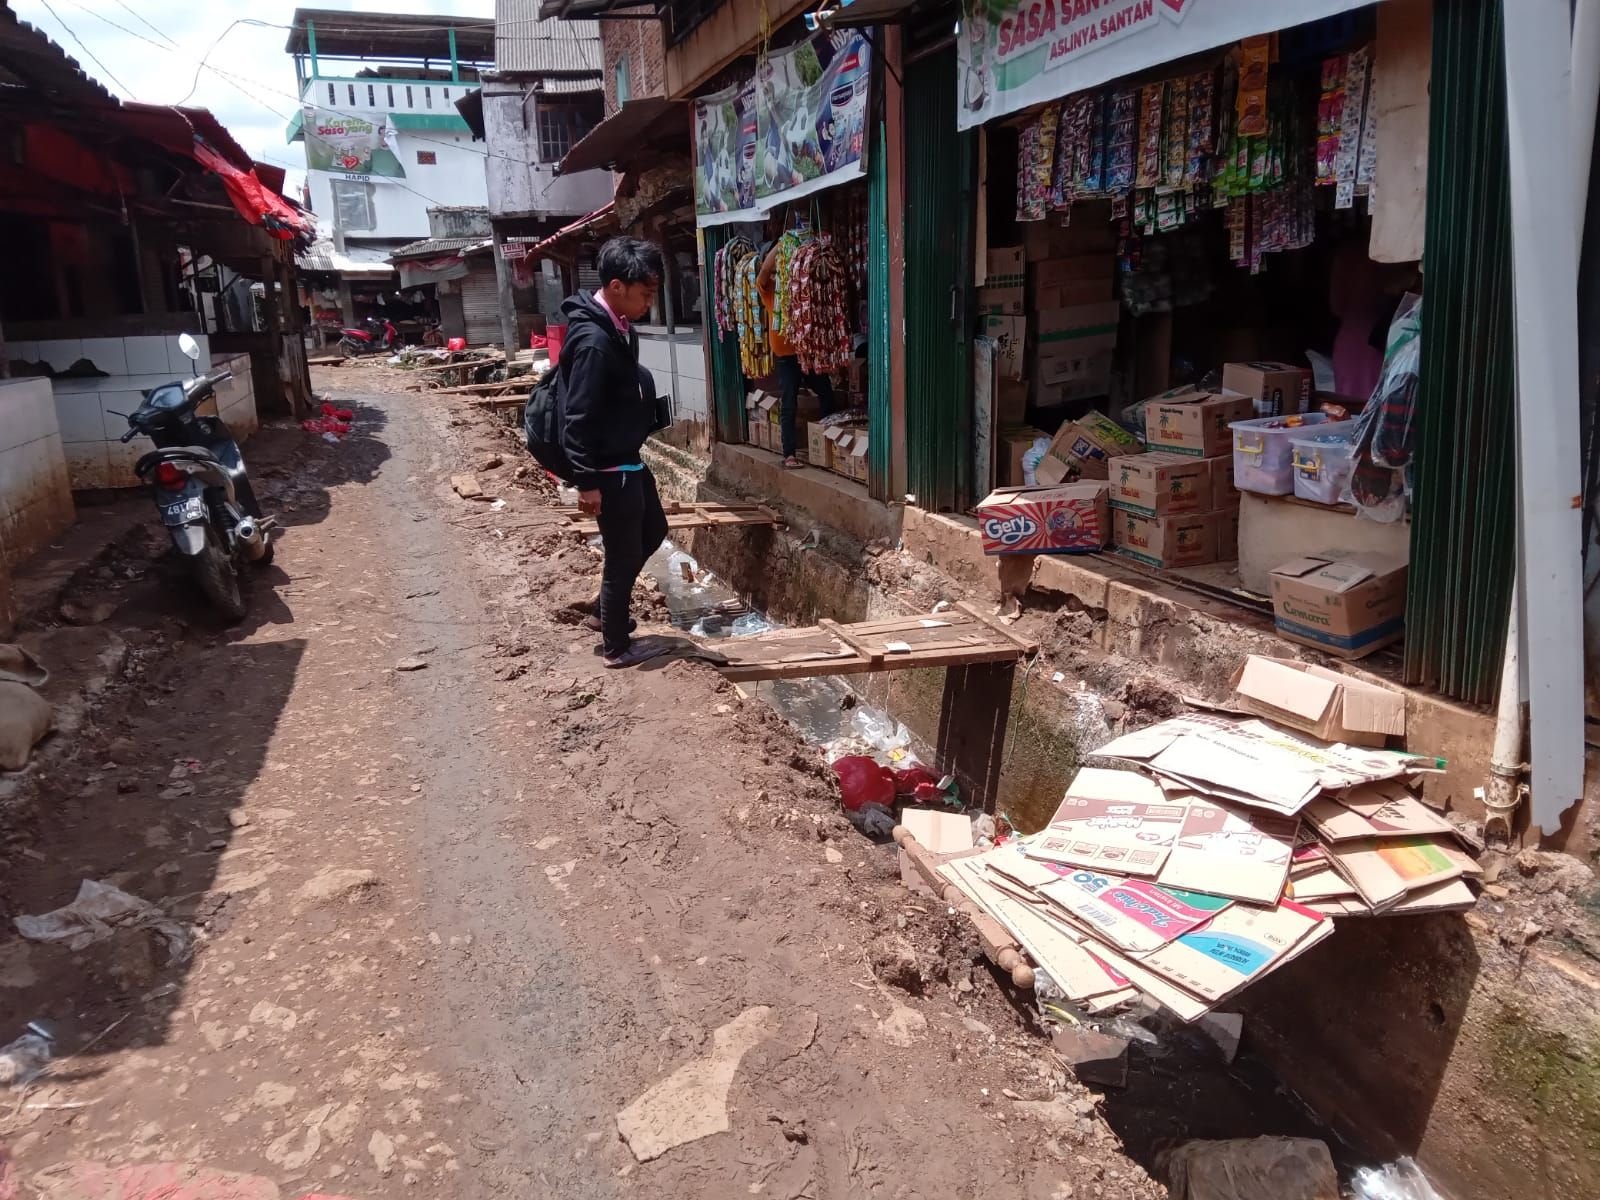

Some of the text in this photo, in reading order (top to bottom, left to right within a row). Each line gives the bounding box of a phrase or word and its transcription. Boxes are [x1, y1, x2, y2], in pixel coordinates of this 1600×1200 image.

[998, 0, 1056, 56] SASA
[1050, 1, 1152, 60] ASLINYA SANTAN
[345, 173, 370, 182] HAPID
[985, 516, 1037, 545] Gery
[1073, 872, 1109, 888] 50
